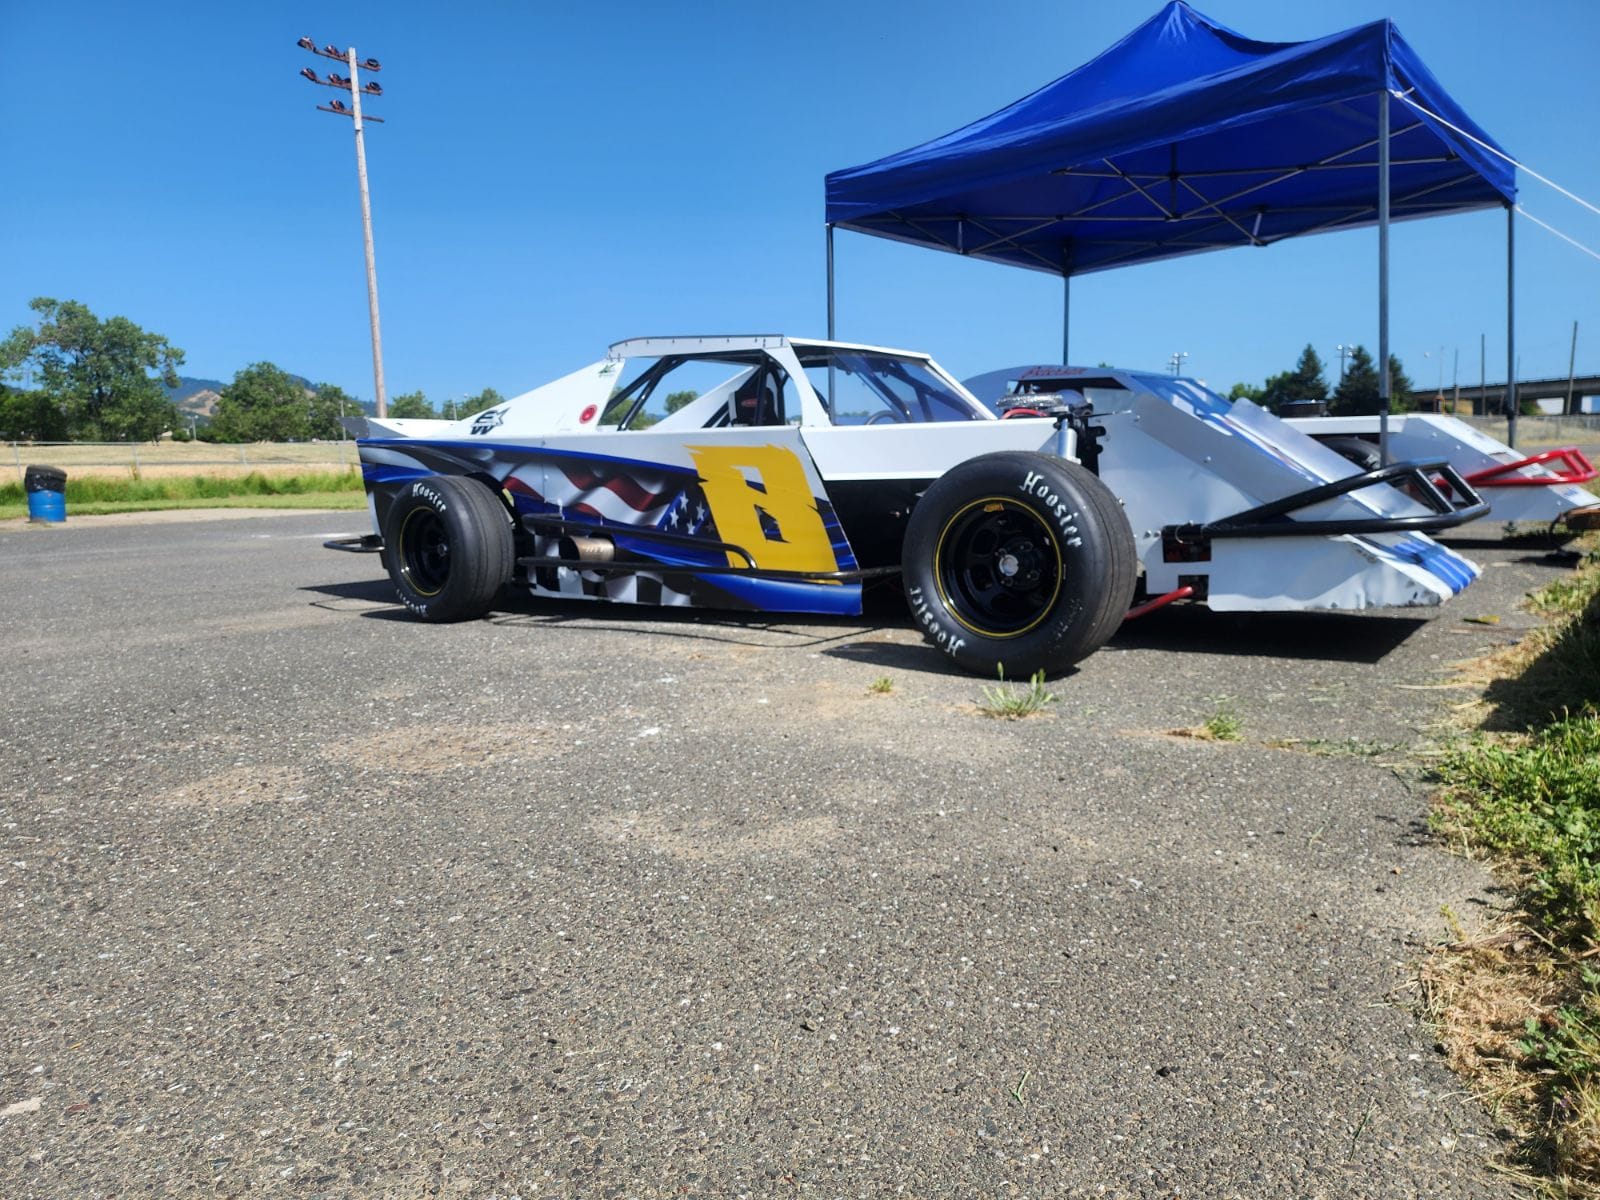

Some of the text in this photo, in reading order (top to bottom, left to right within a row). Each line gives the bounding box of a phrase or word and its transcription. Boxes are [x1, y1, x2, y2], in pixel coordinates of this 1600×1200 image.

[412, 482, 447, 513] Hoosier
[1018, 469, 1083, 549] Hoosier
[909, 586, 968, 658] Hoosier
